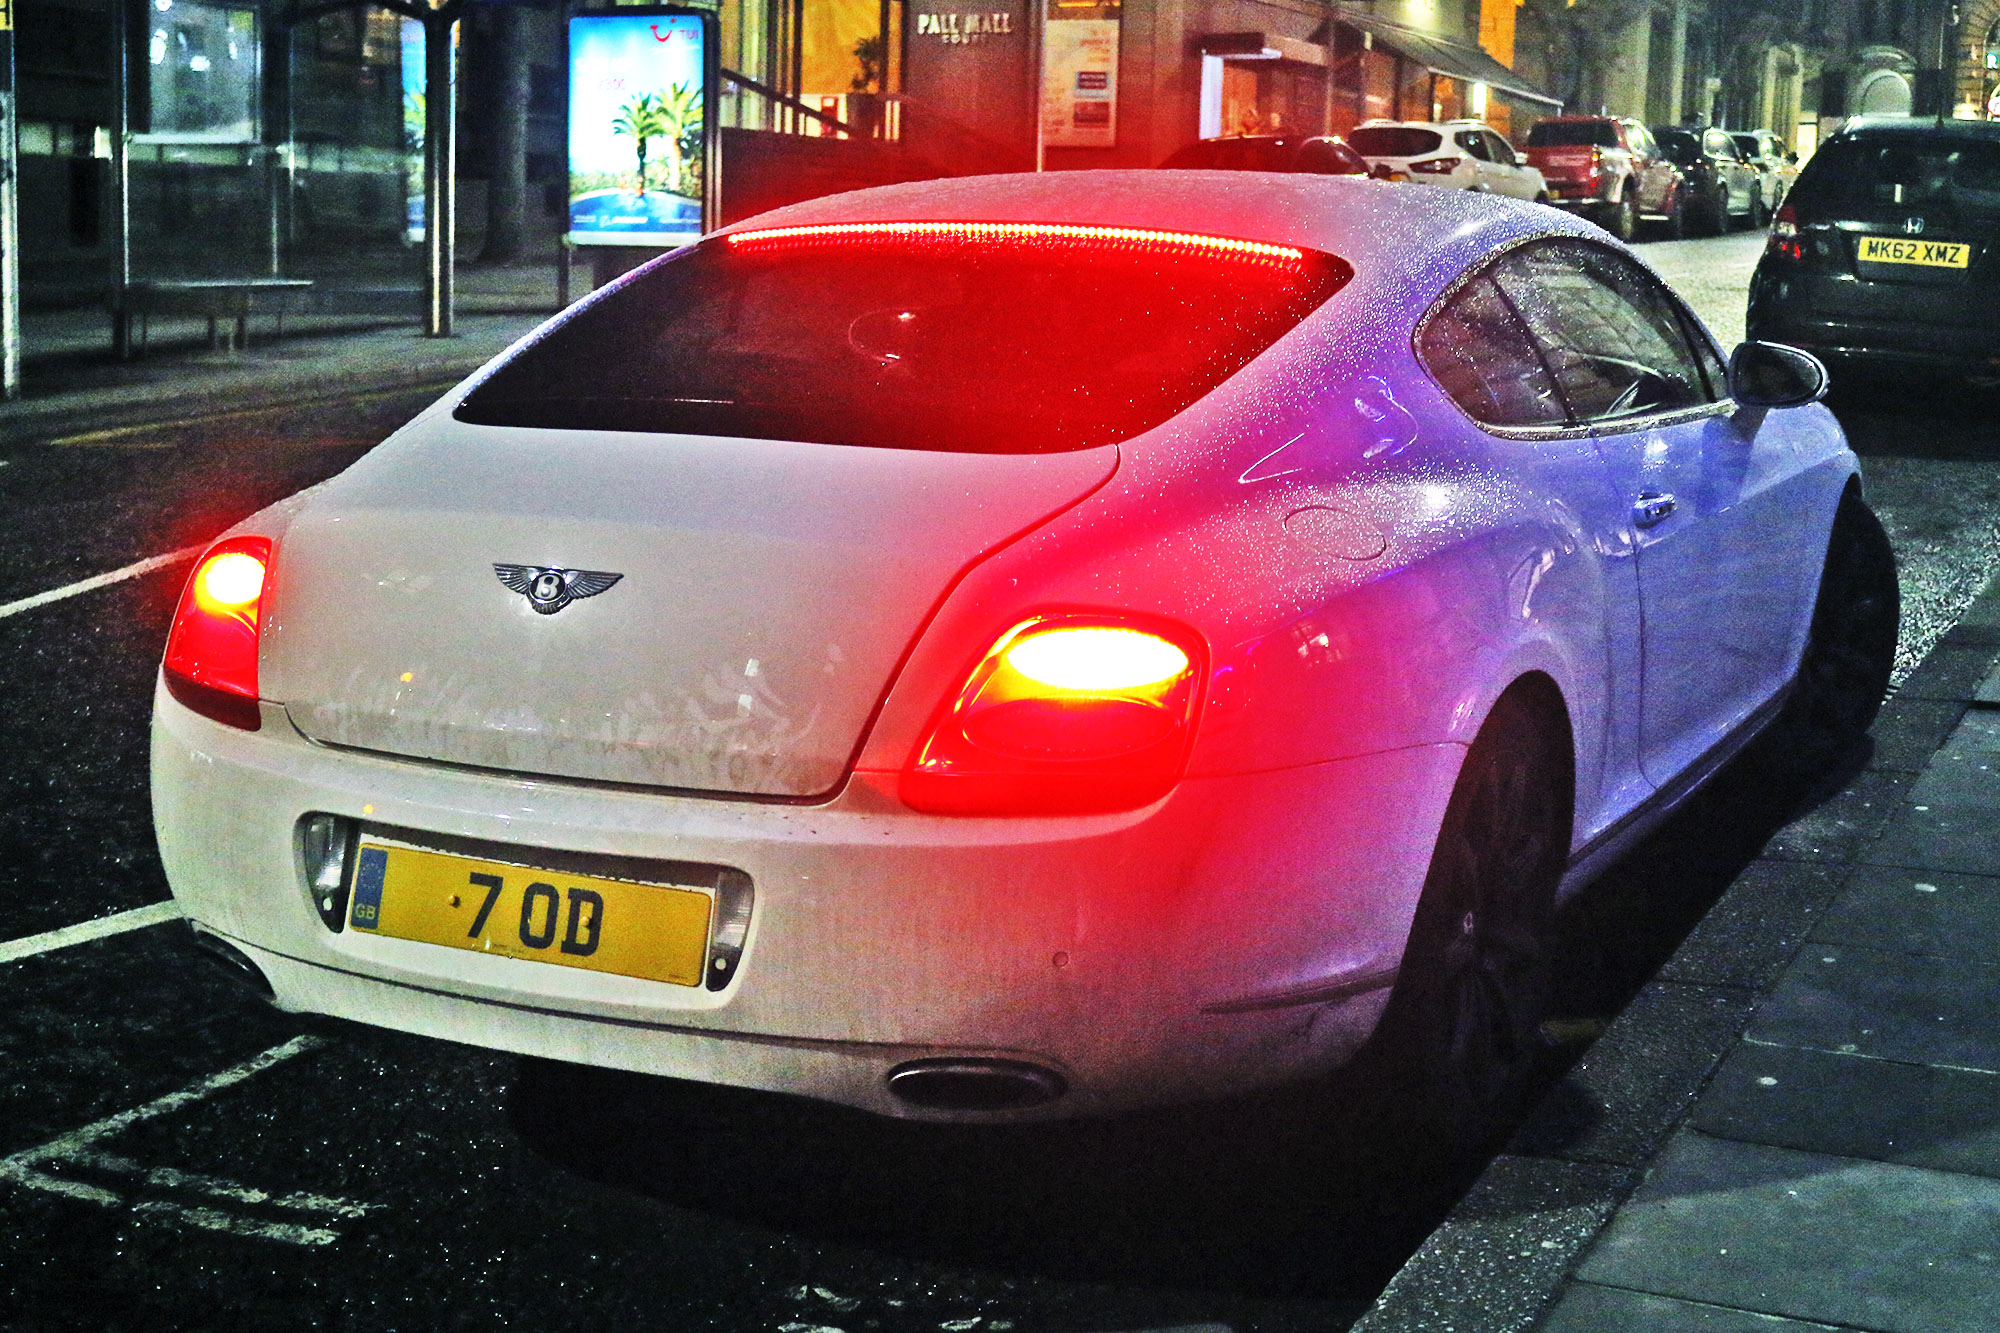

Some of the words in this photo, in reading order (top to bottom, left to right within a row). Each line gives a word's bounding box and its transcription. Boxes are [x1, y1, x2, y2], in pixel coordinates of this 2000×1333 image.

[918, 13, 959, 34] PALL
[965, 13, 1012, 33] MALL
[680, 29, 699, 40] TUI
[1867, 240, 1917, 260] MK62
[1923, 244, 1961, 263] XMZ
[355, 903, 376, 920] GB
[467, 872, 504, 939] 7
